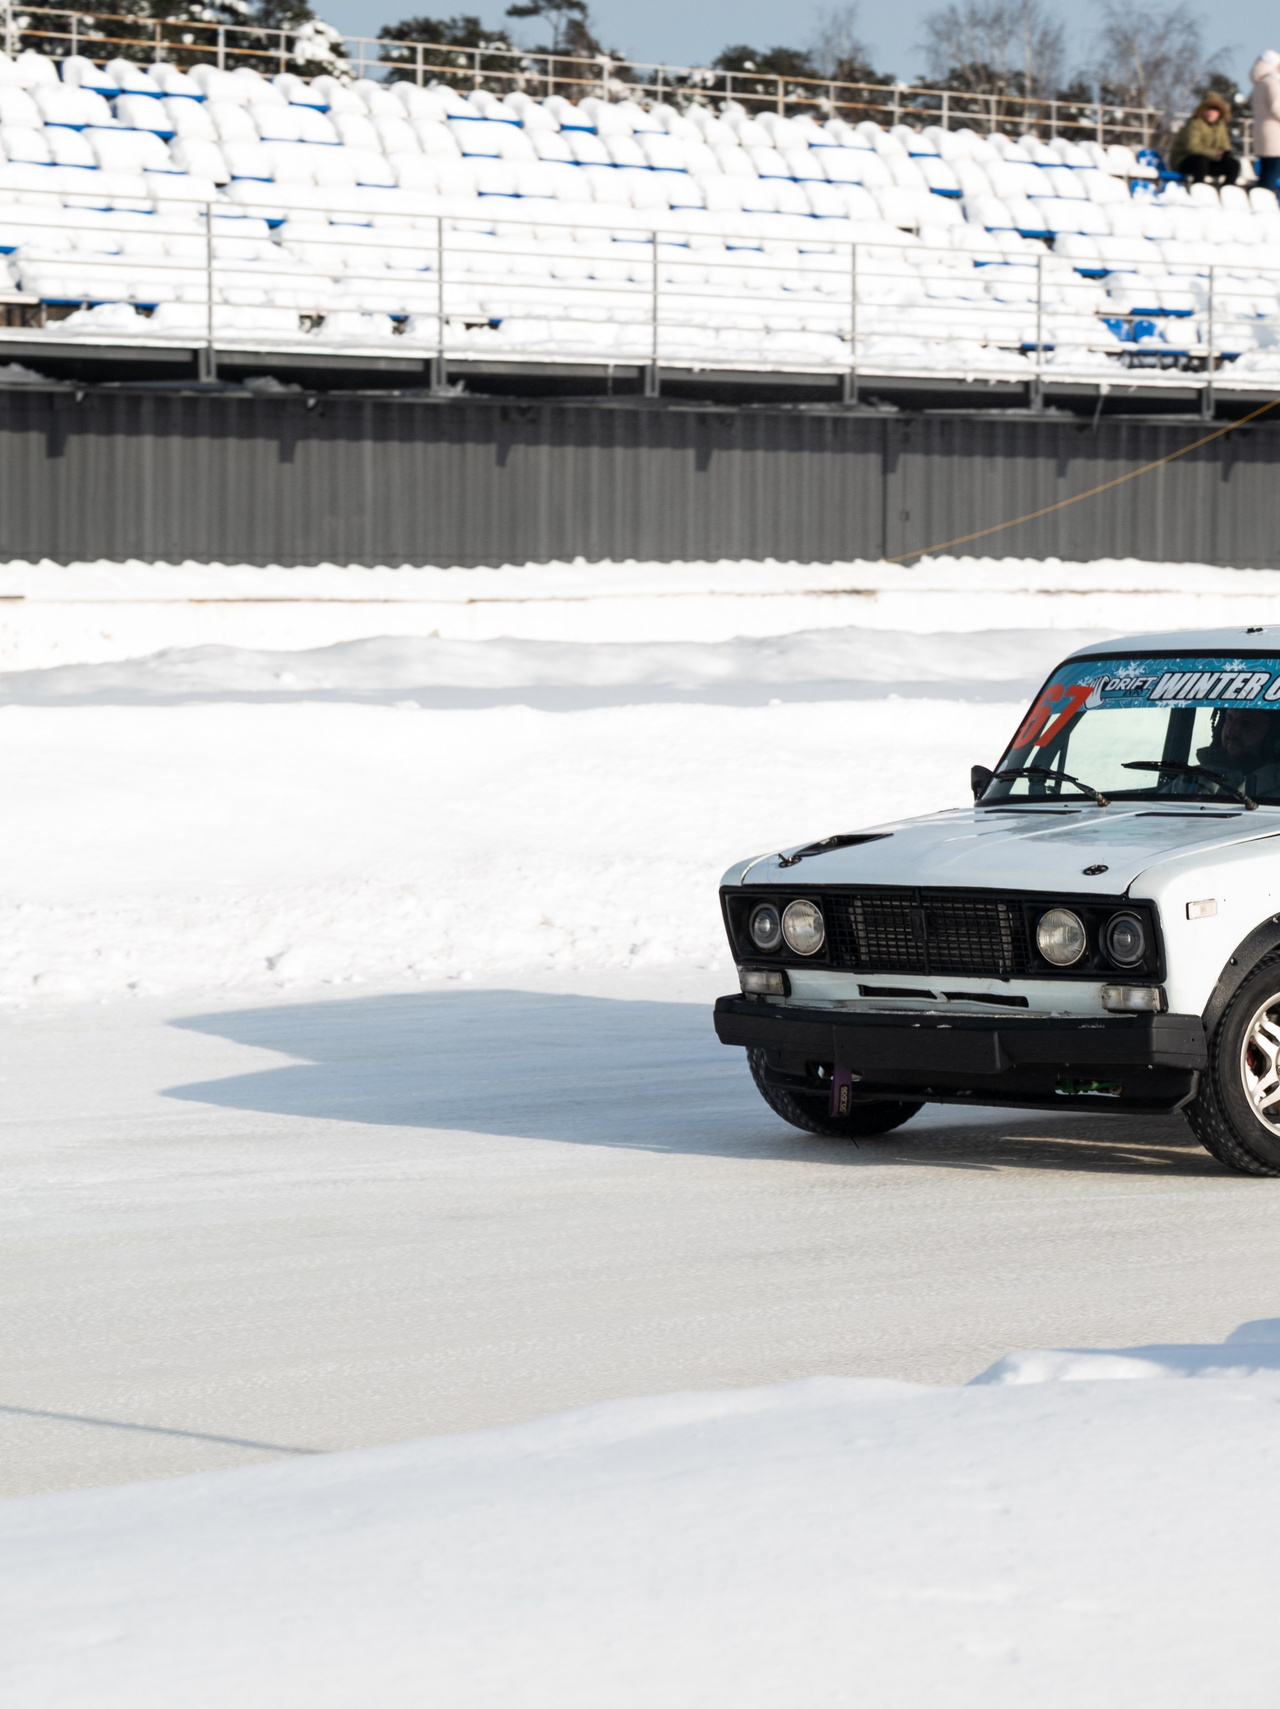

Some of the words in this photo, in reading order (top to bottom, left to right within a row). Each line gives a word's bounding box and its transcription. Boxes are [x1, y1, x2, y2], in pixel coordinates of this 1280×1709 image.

[1104, 677, 1158, 691] DRIFT
[1149, 671, 1272, 701] WINTER
[1012, 683, 1095, 750] 67
